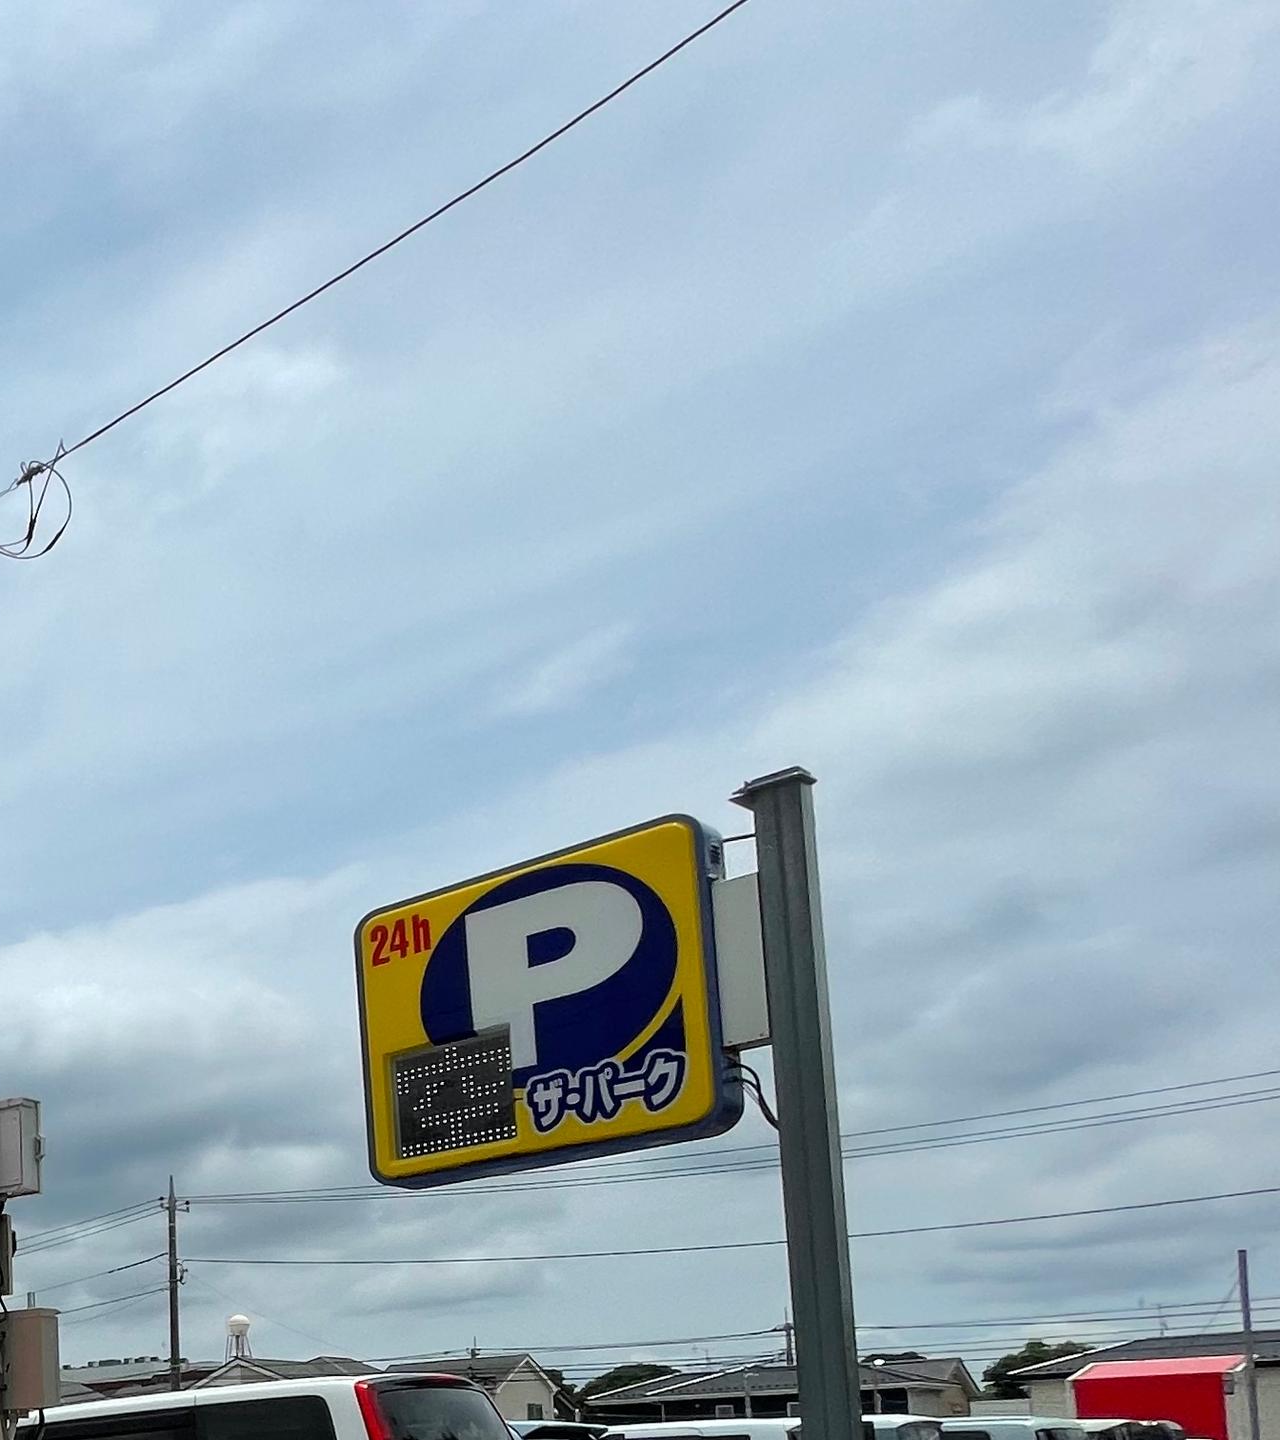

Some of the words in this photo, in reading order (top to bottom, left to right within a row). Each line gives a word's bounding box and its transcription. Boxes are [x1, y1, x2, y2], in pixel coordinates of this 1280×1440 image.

[369, 914, 432, 967] 24h
[464, 881, 644, 1071] P
[396, 1046, 517, 1158] 空
